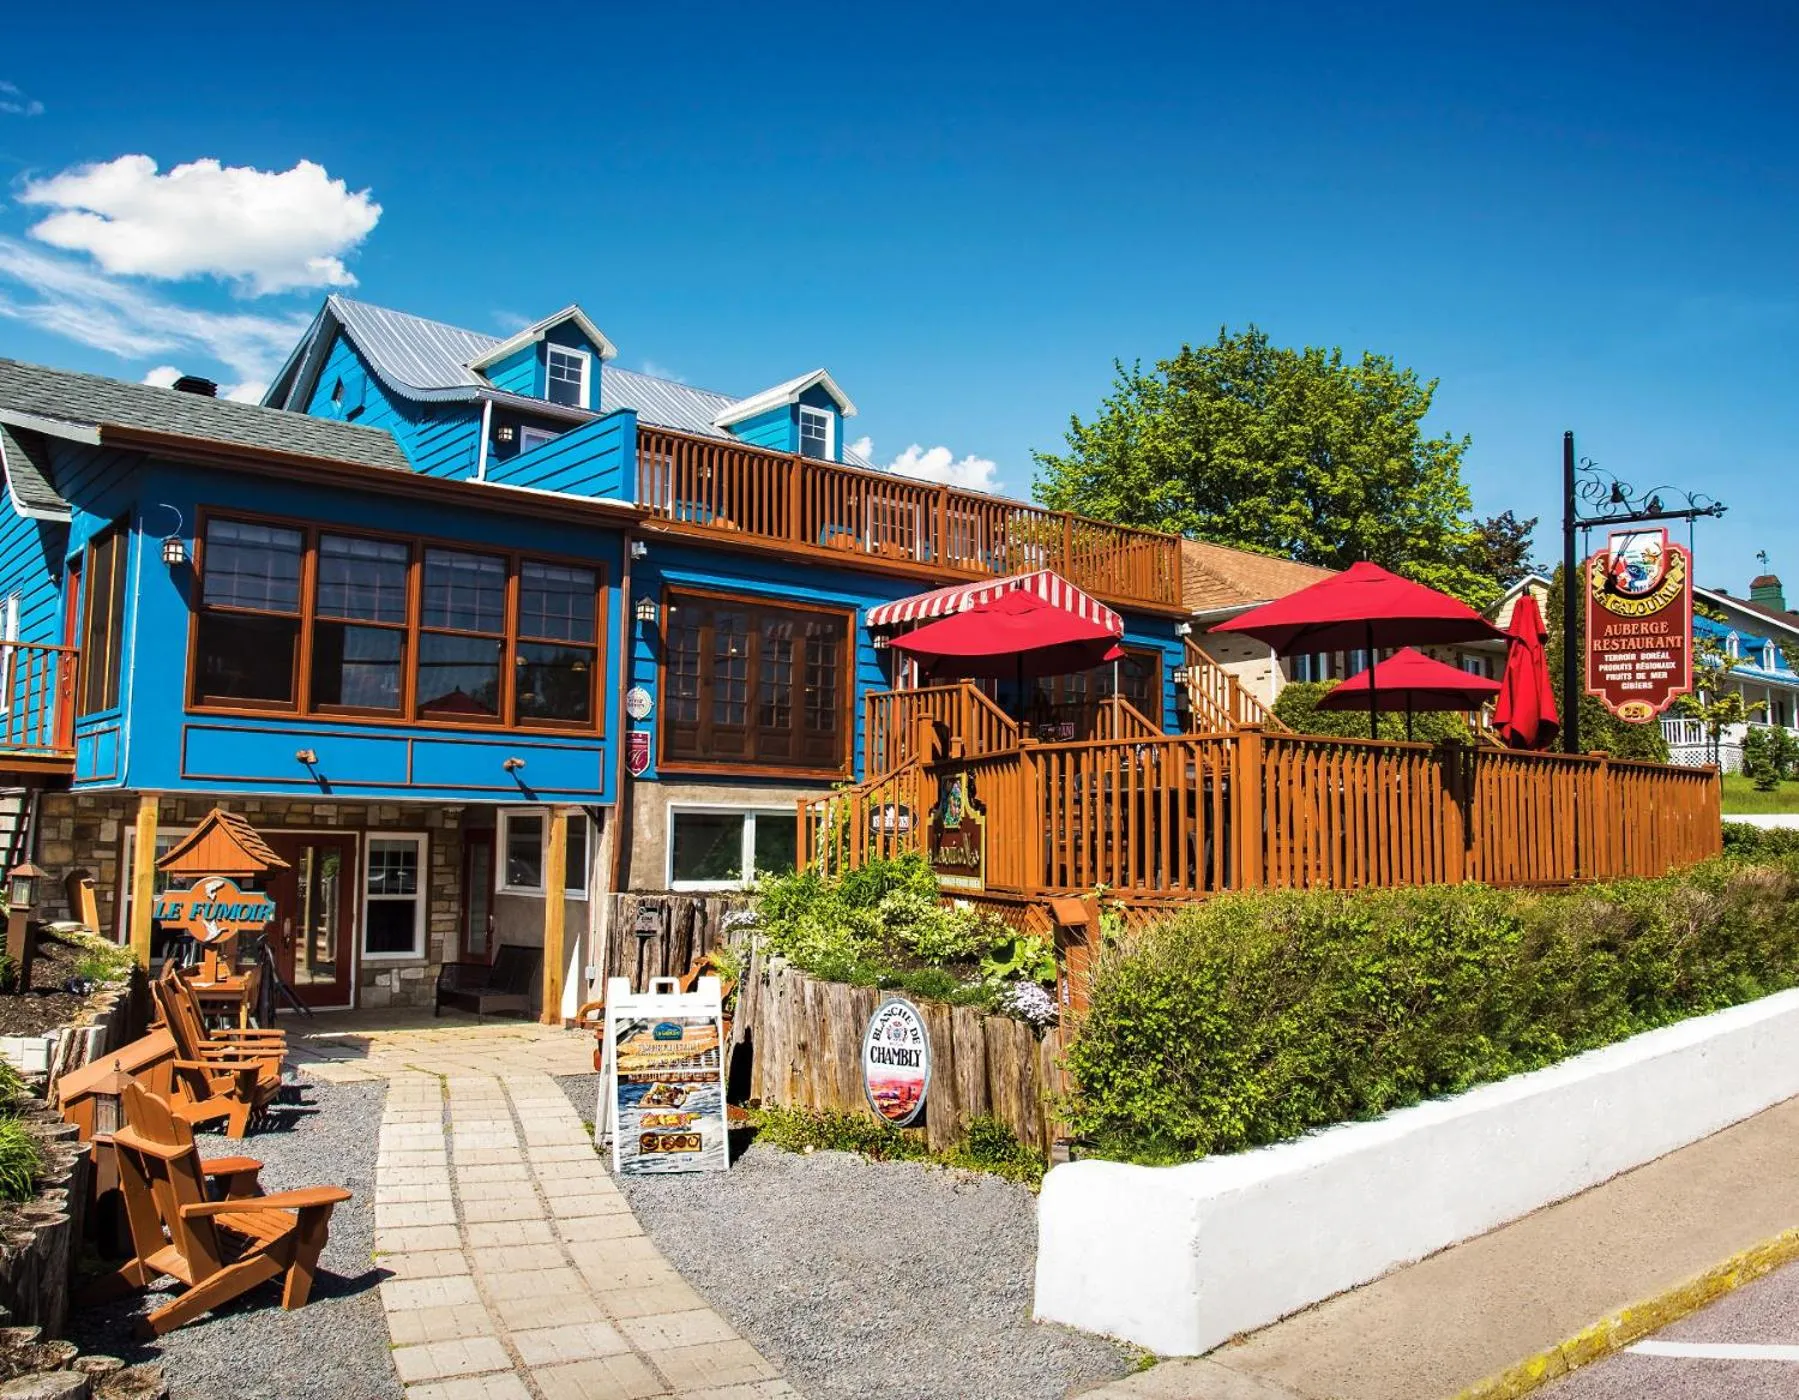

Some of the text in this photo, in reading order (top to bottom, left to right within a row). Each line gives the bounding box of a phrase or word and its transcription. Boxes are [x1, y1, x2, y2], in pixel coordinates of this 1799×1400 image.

[1603, 621, 1669, 637] AUBERGE
[1592, 635, 1683, 651] RESTAURANT
[1635, 672, 1647, 680] DE
[1650, 671, 1668, 680] MER
[153, 901, 272, 923] LE FUMOIR
[872, 1006, 921, 1045] BLANCHE DE
[870, 1045, 922, 1068] CHAMBLY
